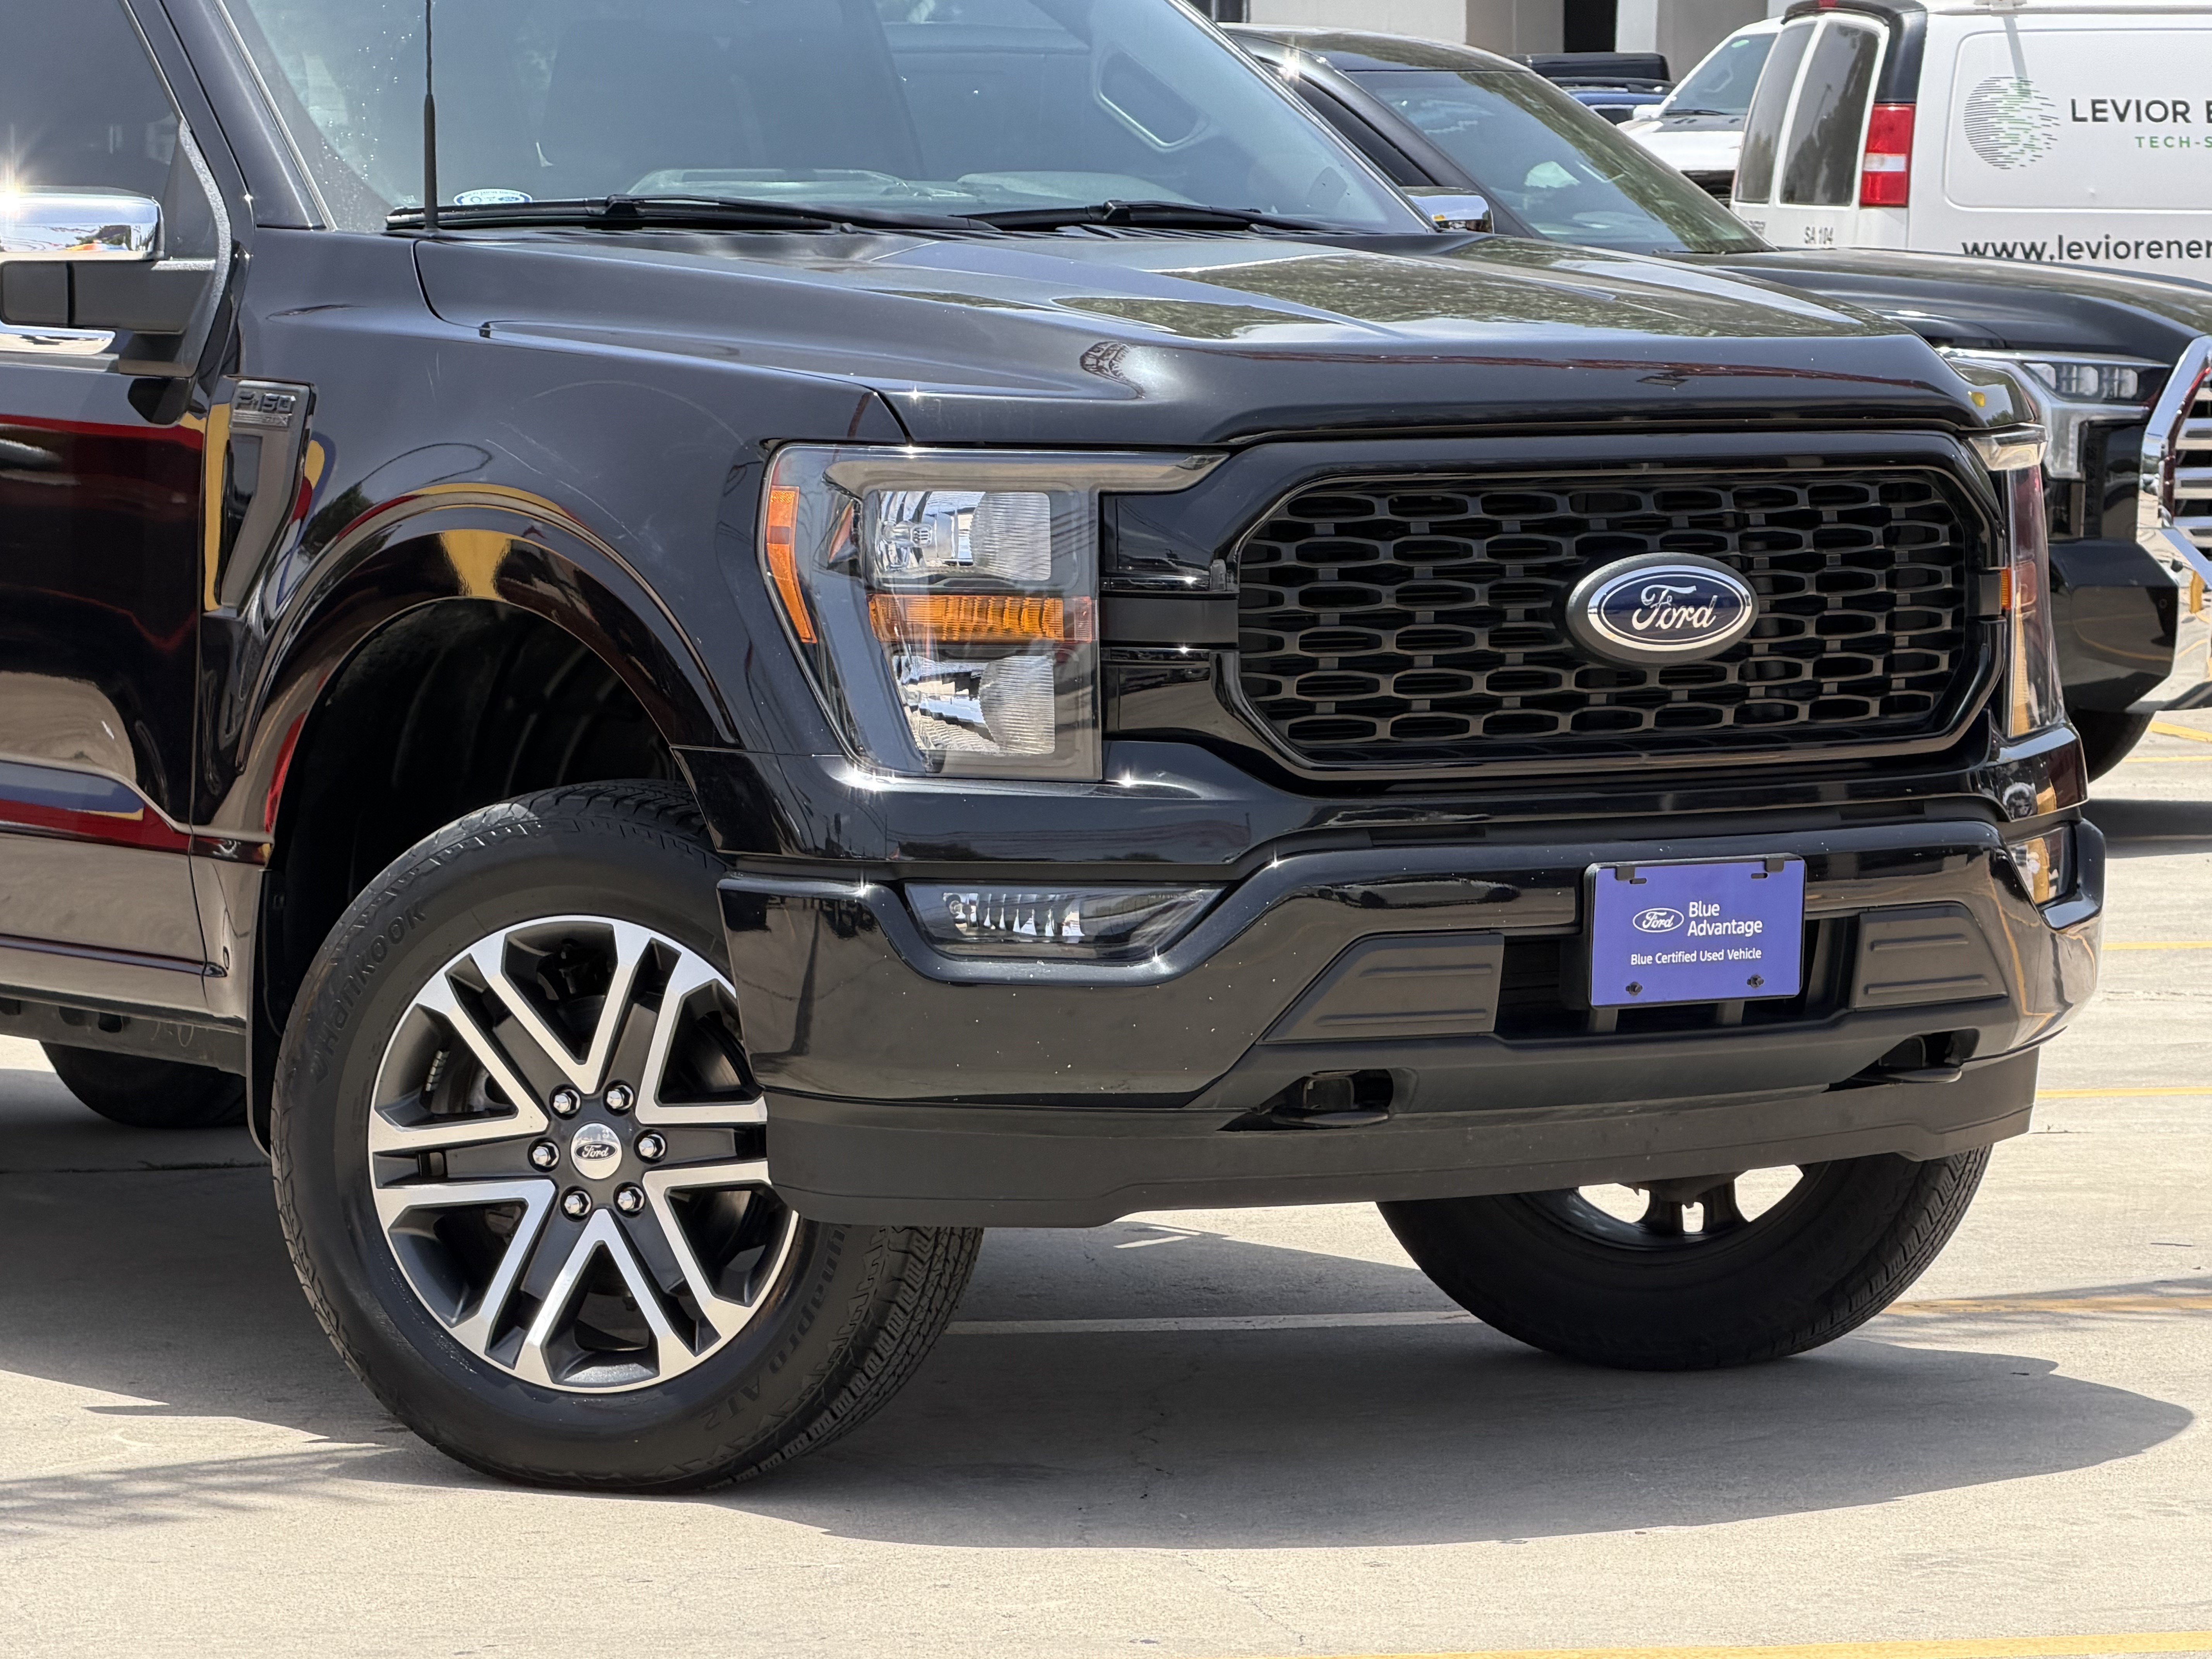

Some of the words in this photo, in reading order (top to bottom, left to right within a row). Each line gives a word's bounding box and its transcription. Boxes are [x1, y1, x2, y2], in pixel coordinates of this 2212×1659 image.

[2071, 98, 2192, 123] LEVIOR
[1804, 226, 1816, 244] SA
[1632, 584, 1718, 630] Ford
[1689, 900, 1720, 917] Blue
[1642, 911, 1674, 928] Ford
[1687, 919, 1763, 937] Advantage
[1631, 953, 1653, 965] Blue
[1655, 950, 1697, 963] Certified
[1700, 949, 1724, 962] Used
[1727, 947, 1762, 960] Vehicle
[582, 1145, 609, 1158] Ford
[768, 1224, 852, 1374] ynapro
